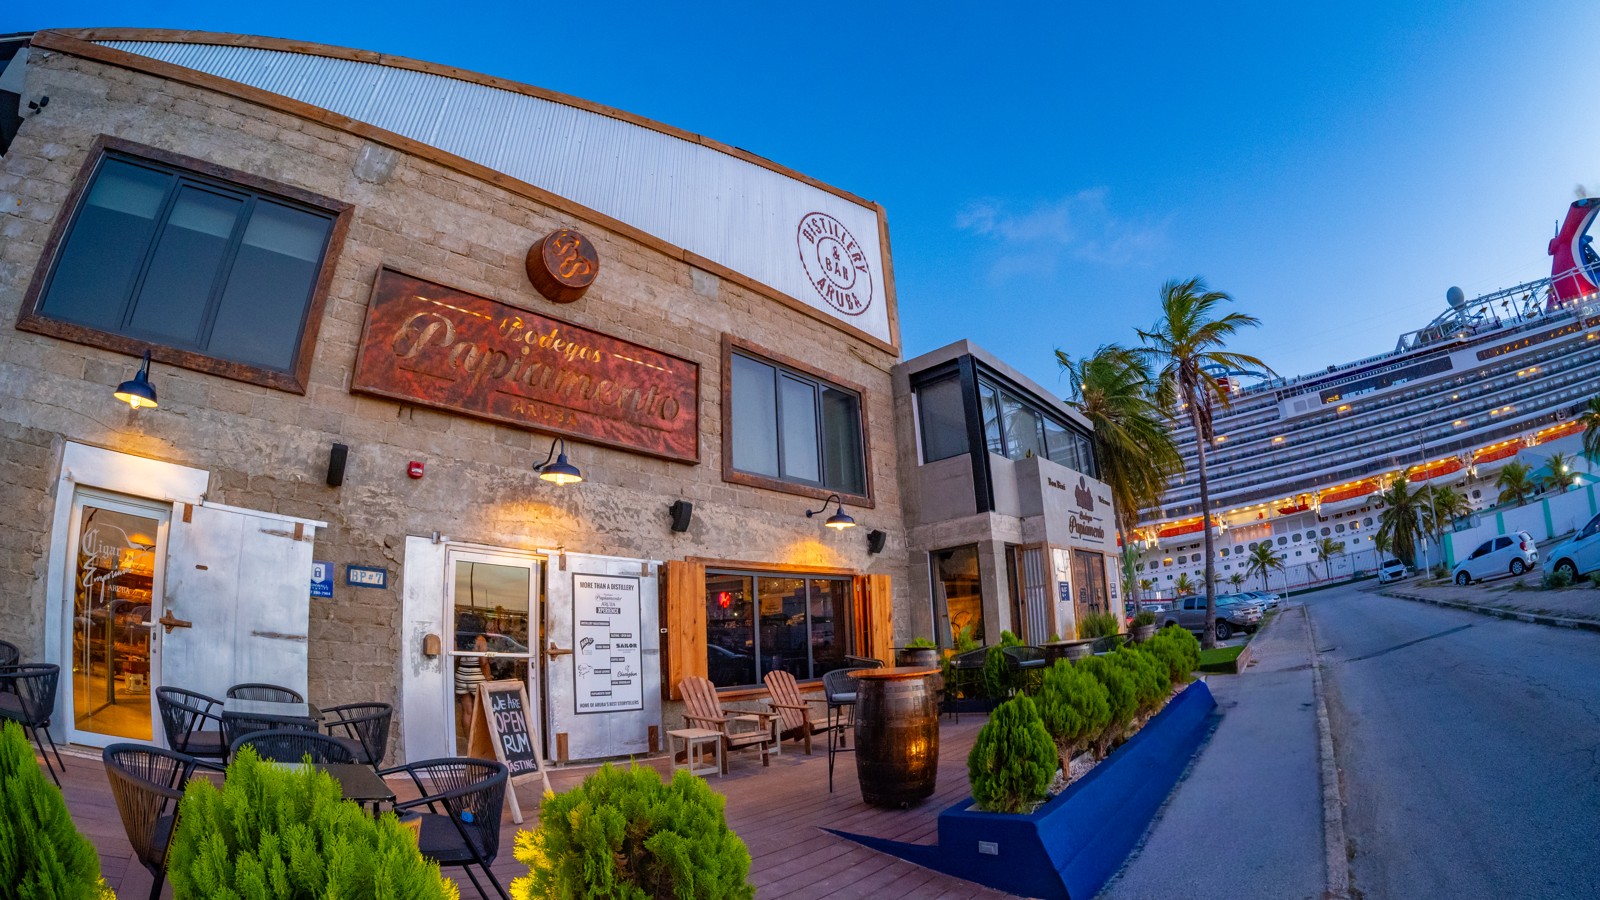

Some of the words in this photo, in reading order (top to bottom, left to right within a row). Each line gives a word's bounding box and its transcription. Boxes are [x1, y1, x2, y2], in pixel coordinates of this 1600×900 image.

[803, 218, 867, 273] DISTILLERY
[825, 257, 848, 280] BAR
[817, 277, 862, 310] ARUBA
[499, 316, 602, 363] Bodegas
[392, 311, 680, 421] Papiamento
[1069, 515, 1104, 539] Papiamento
[82, 527, 121, 558] Cigar
[580, 581, 593, 589] MORE
[594, 582, 606, 590] THAN
[611, 583, 635, 591] DISTILLERY
[494, 710, 527, 733] OPEN
[503, 733, 531, 755] RUM
[507, 759, 537, 774] TASTING
